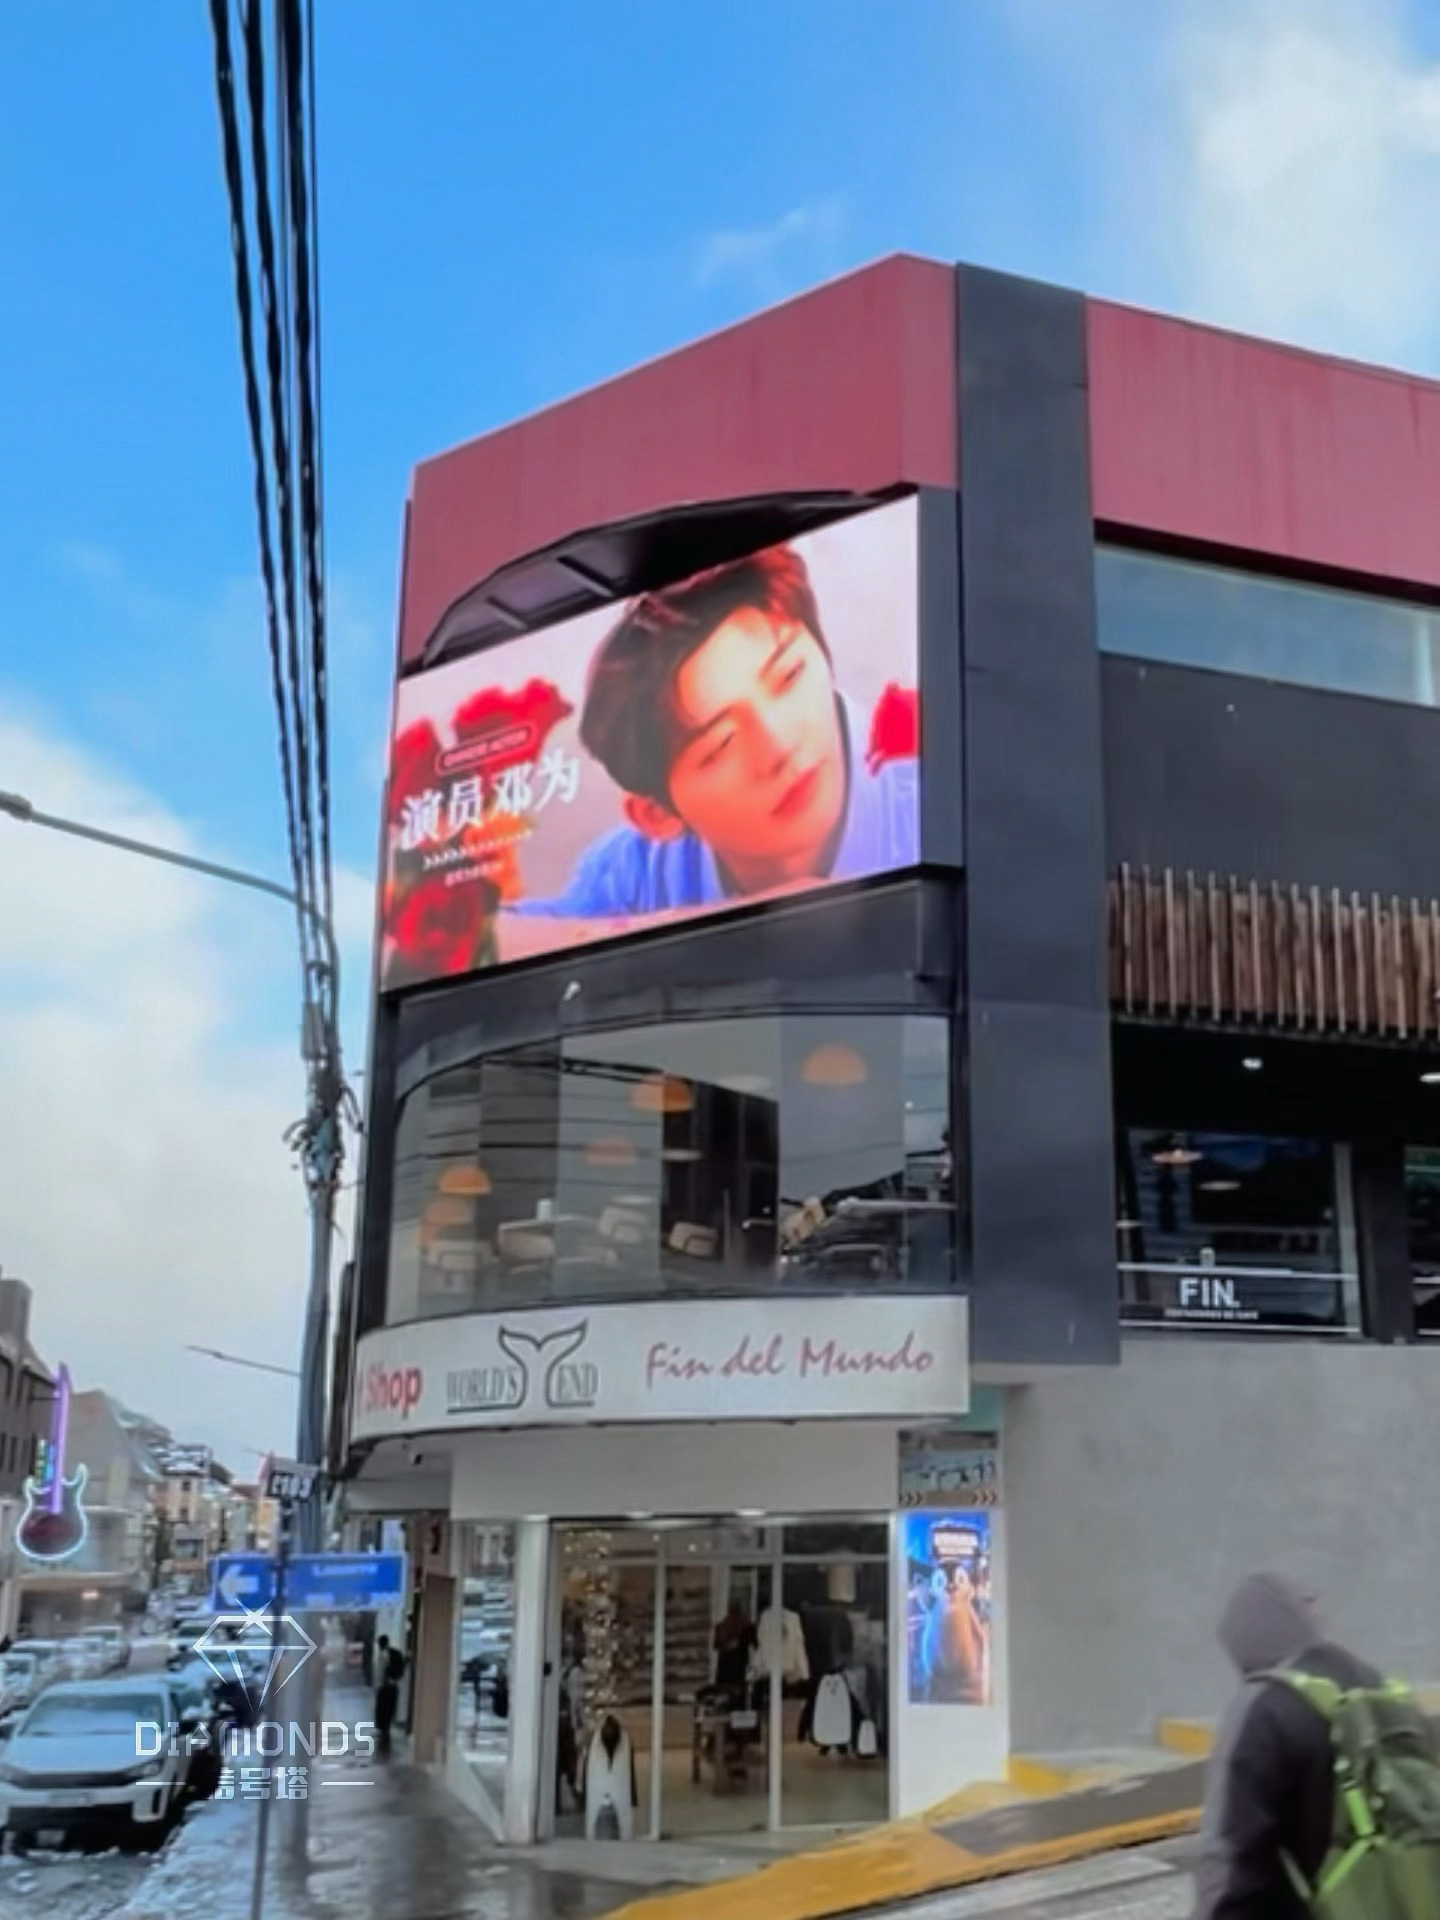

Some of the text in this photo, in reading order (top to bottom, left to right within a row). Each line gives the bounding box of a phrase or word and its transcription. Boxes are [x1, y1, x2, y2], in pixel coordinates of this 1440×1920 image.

[399, 748, 579, 850] 演员邓为
[645, 1330, 934, 1390] Fin del Mundo
[366, 1361, 422, 1421] Shop
